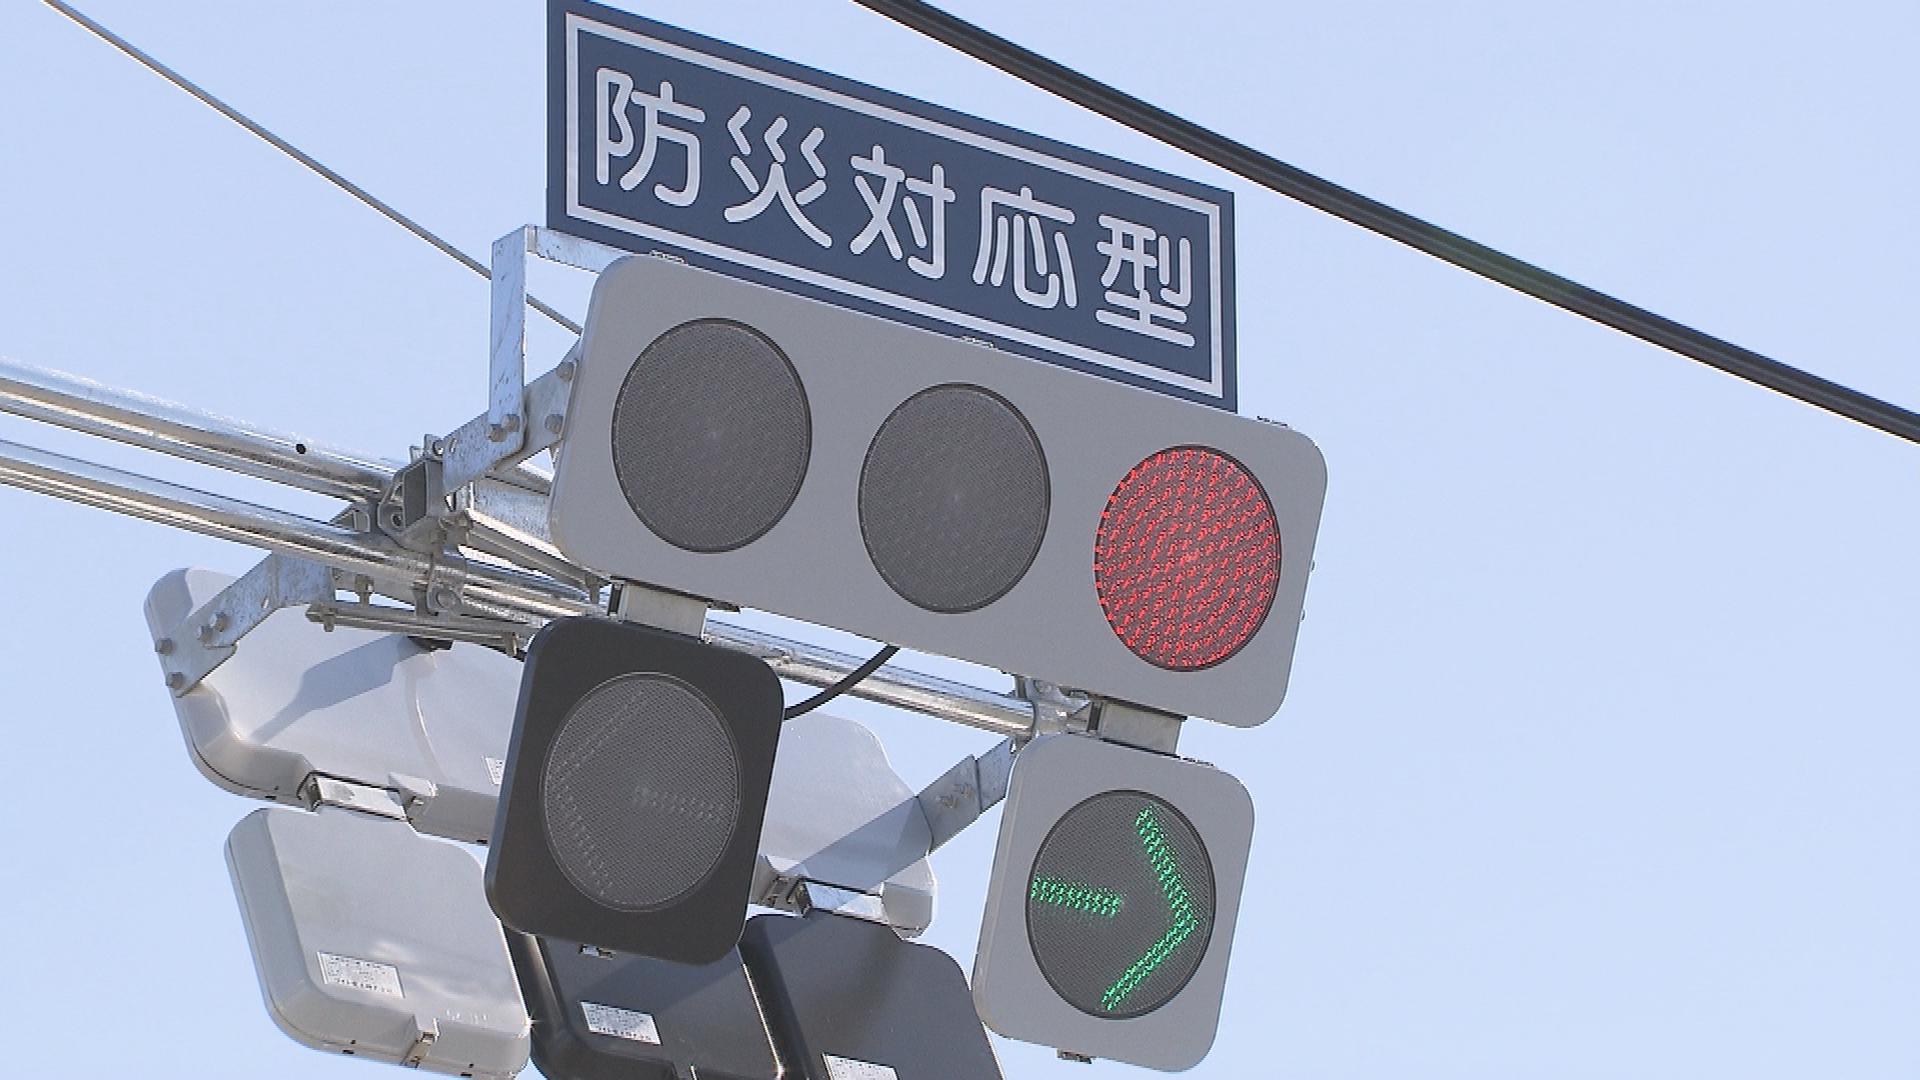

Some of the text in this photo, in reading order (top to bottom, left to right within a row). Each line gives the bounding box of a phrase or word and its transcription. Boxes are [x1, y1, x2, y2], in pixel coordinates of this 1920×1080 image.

[596, 67, 1196, 347] 防災対応型
